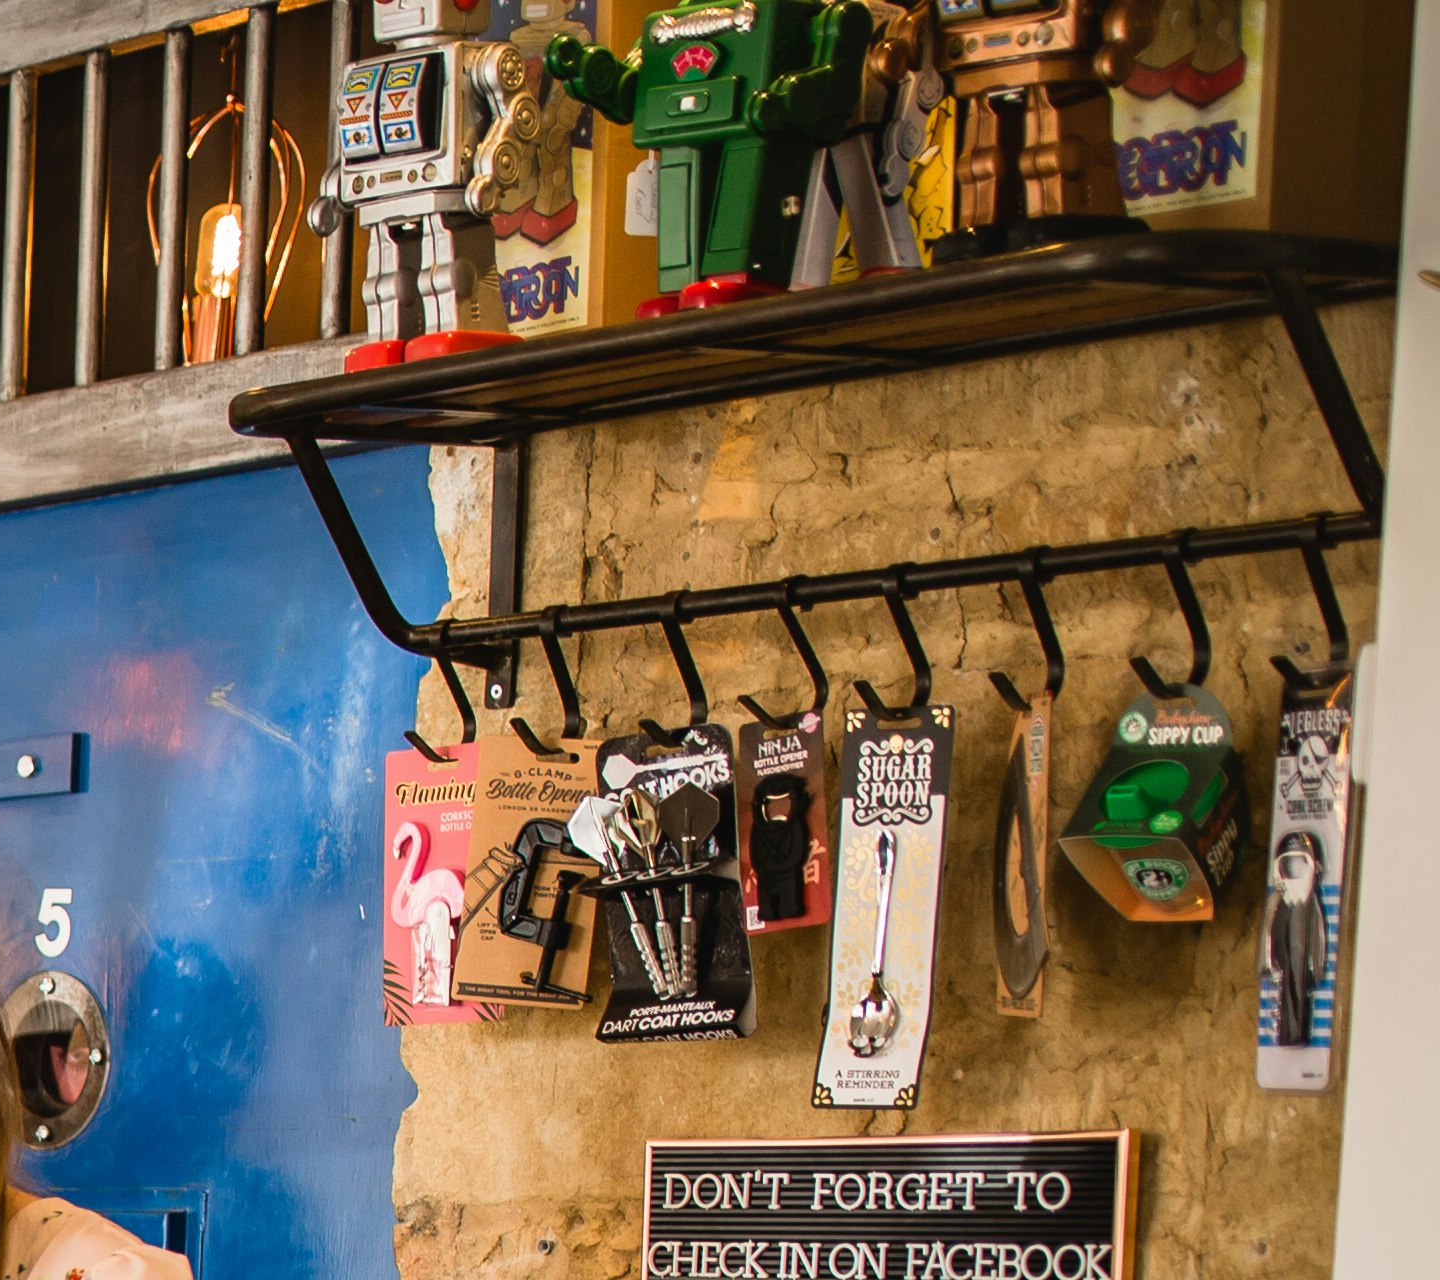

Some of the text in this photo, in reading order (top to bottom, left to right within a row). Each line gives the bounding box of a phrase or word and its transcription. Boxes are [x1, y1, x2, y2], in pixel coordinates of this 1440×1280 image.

[758, 735, 802, 758] NINJA
[1148, 725, 1224, 746] SIPPY CUP
[753, 750, 808, 769] BOTTLE OPENER
[857, 755, 932, 783] SUGAR
[395, 776, 477, 806] Flaming
[485, 778, 538, 800] Bottle
[856, 780, 930, 808] SPOON
[440, 811, 473, 824] CORKSC
[440, 822, 463, 834] BOTTLE
[35, 888, 73, 958] 5
[629, 1001, 716, 1017] PORTE-MANTEAUX
[602, 1010, 735, 1034] DART COAT HOOKS
[835, 1069, 900, 1079] A STIRRING
[836, 1080, 895, 1089] REMINDER
[661, 1169, 1072, 1213] DON'T FORGET TO
[647, 1240, 768, 1280] CHECK
